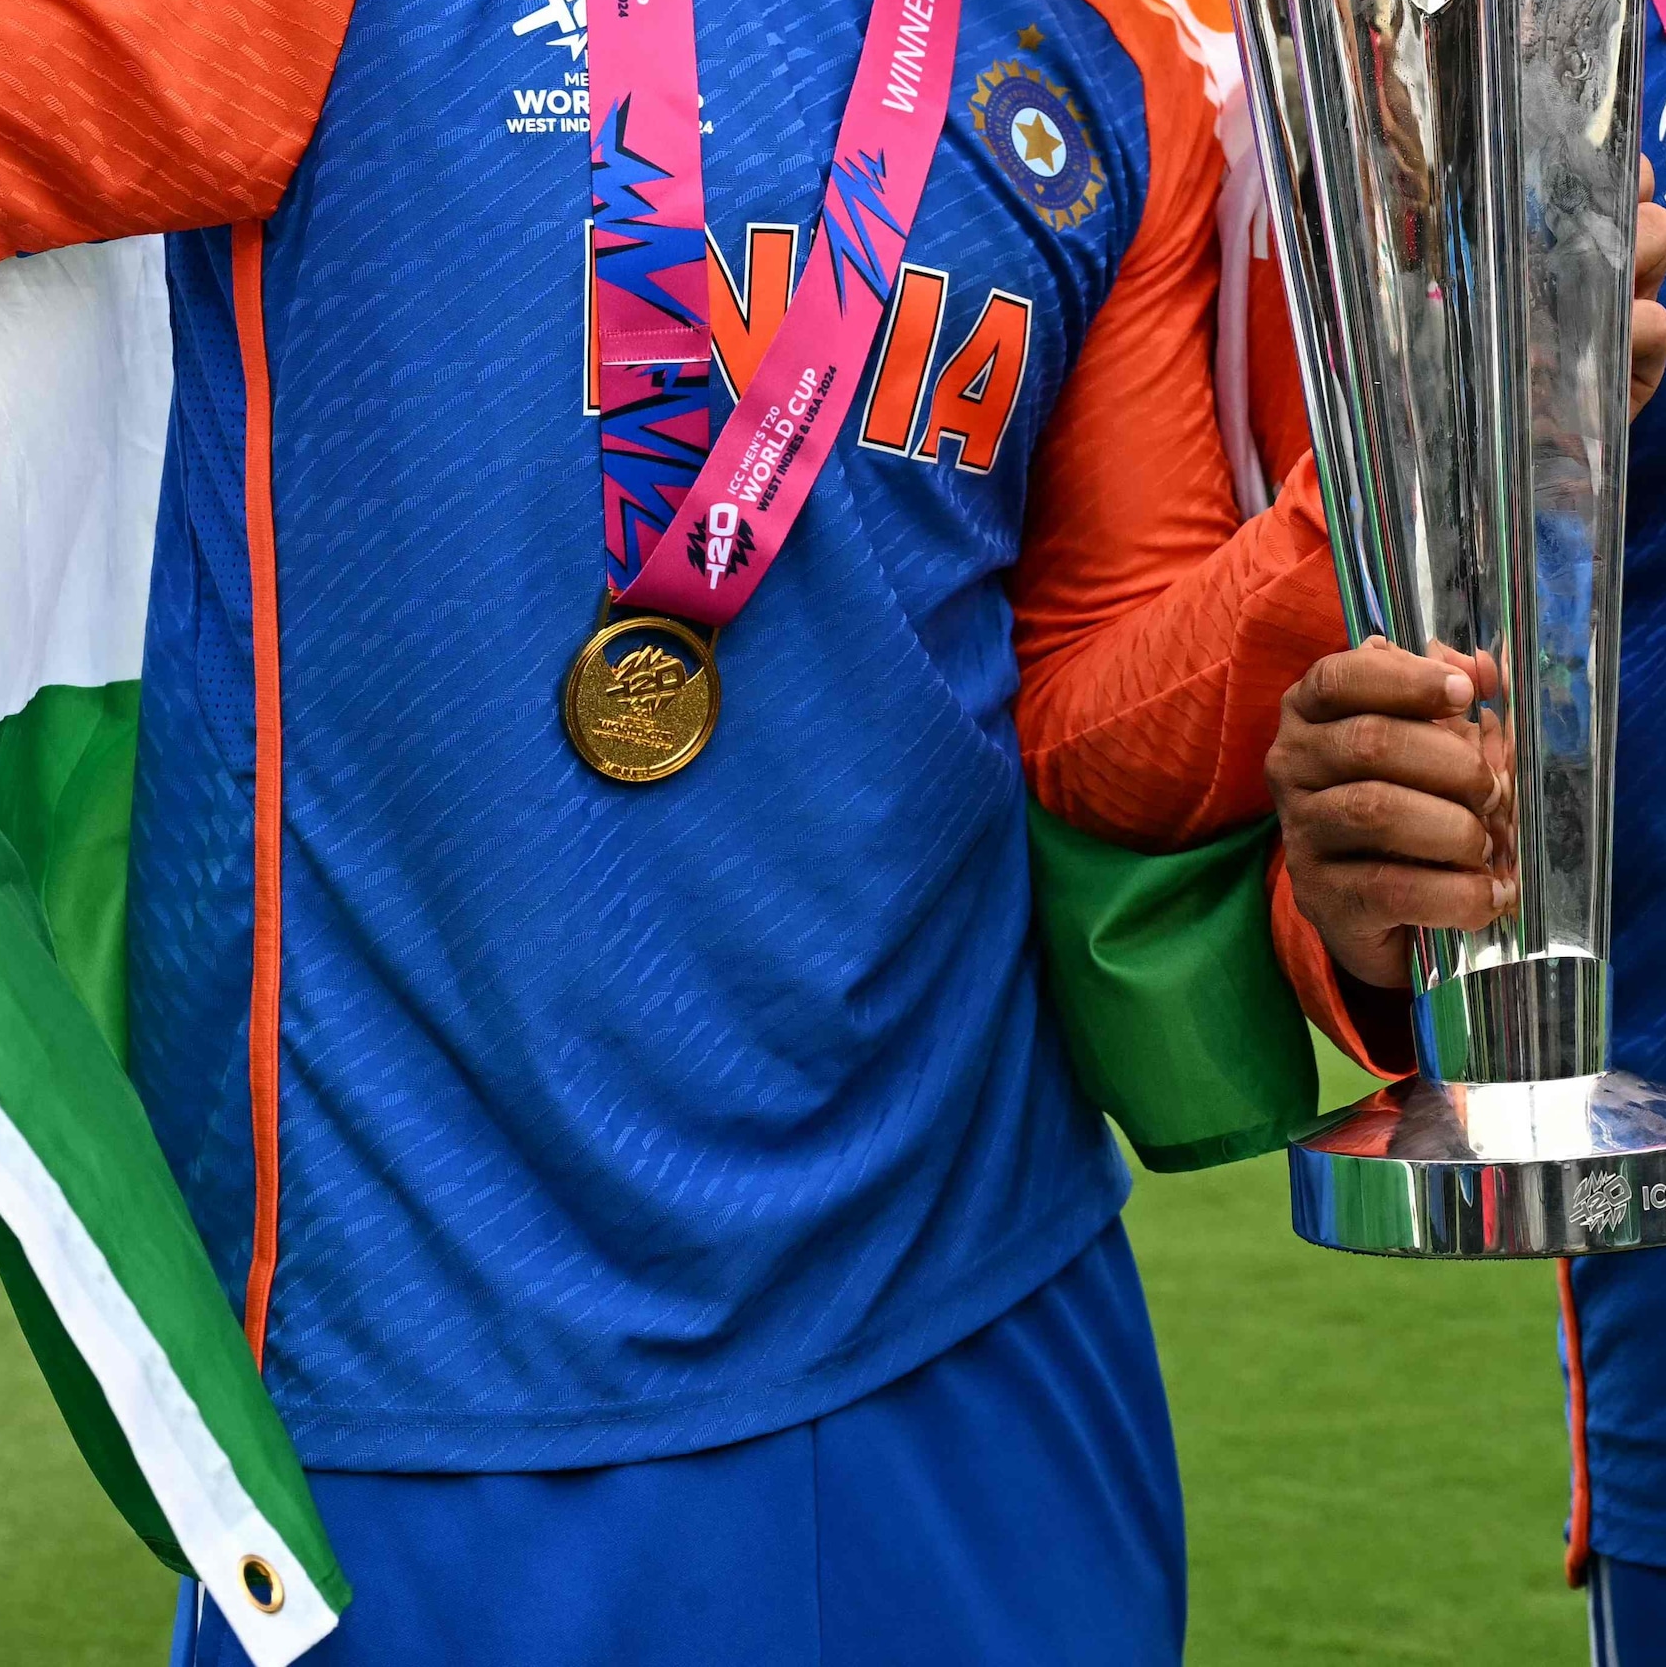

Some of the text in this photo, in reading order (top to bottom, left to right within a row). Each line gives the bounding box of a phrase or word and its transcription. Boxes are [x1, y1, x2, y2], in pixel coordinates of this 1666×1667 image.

[506, 118, 558, 134] WEST
[727, 405, 782, 497] ICC MEN'S T20
[739, 367, 820, 503] WORLD CUP
[756, 365, 838, 513] WEST INDIES & USA 2024
